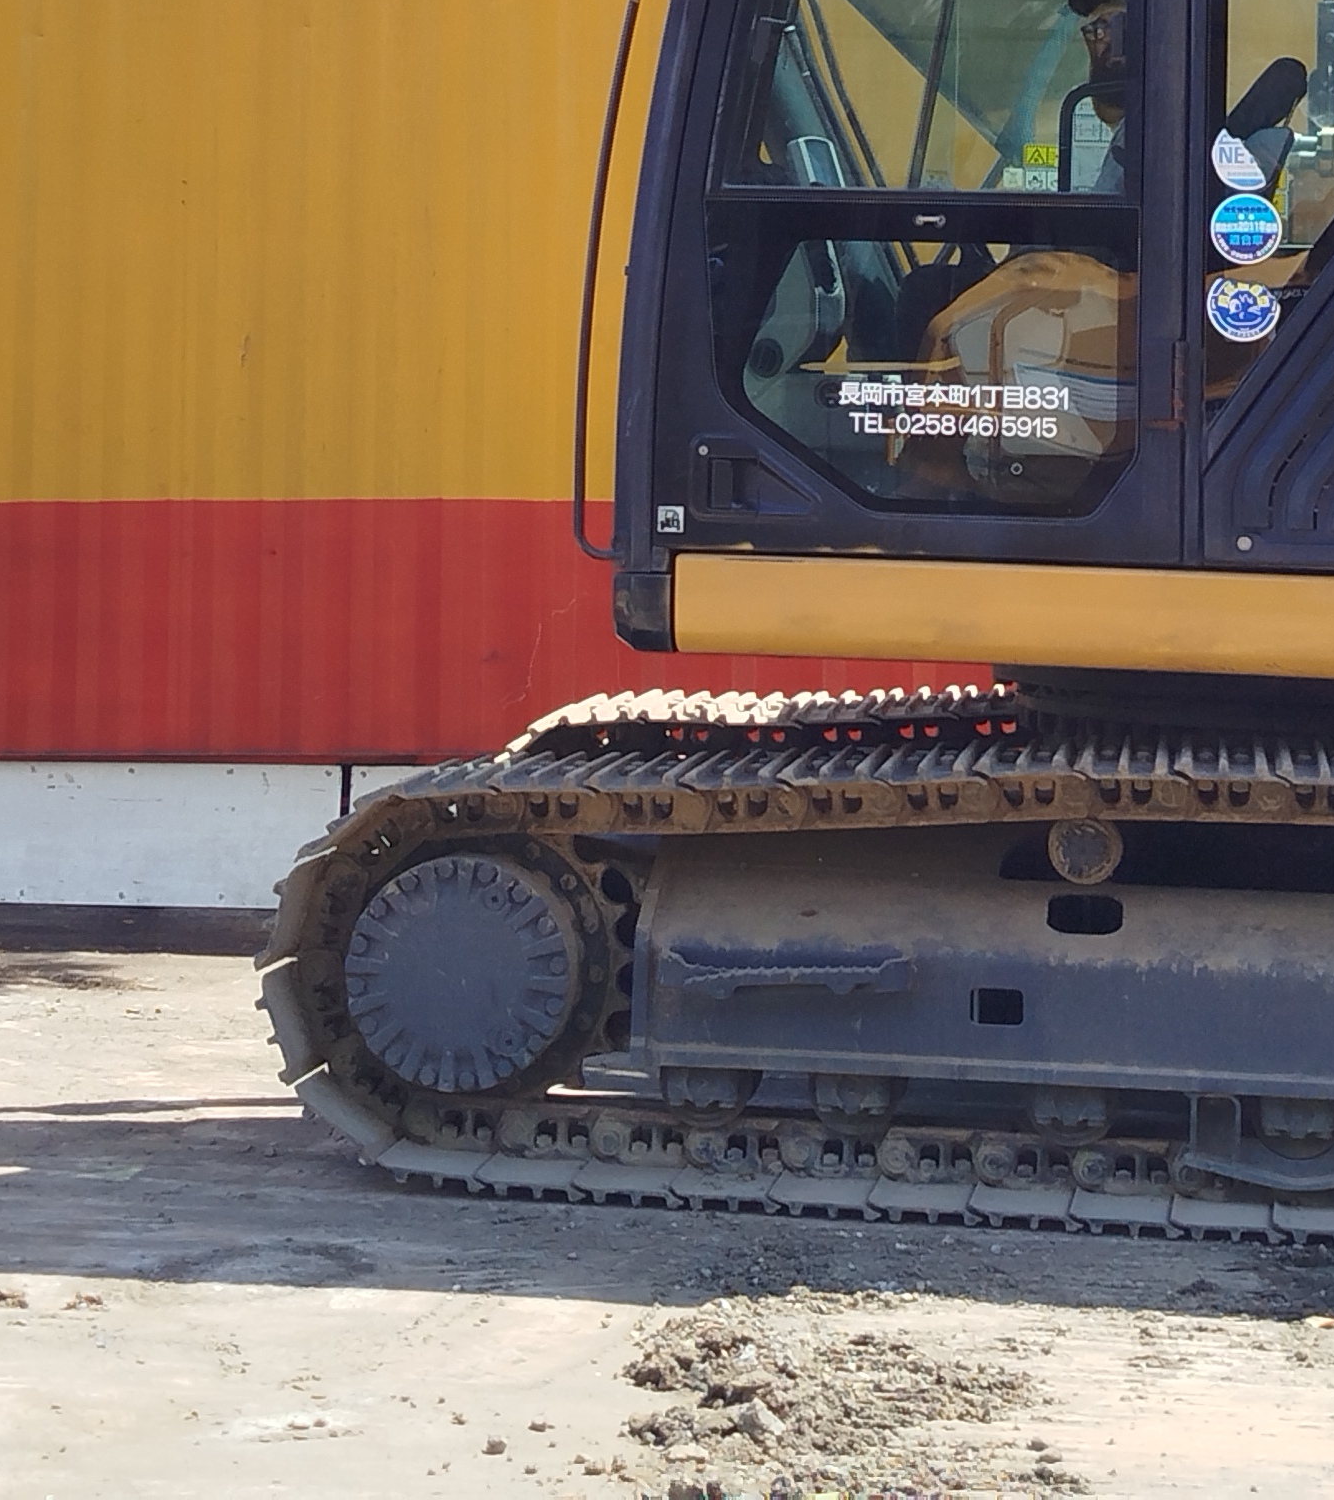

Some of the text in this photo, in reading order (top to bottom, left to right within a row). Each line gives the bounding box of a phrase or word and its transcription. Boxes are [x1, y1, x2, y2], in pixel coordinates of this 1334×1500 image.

[838, 381, 1070, 411] 長岡市宮本町1丁目831
